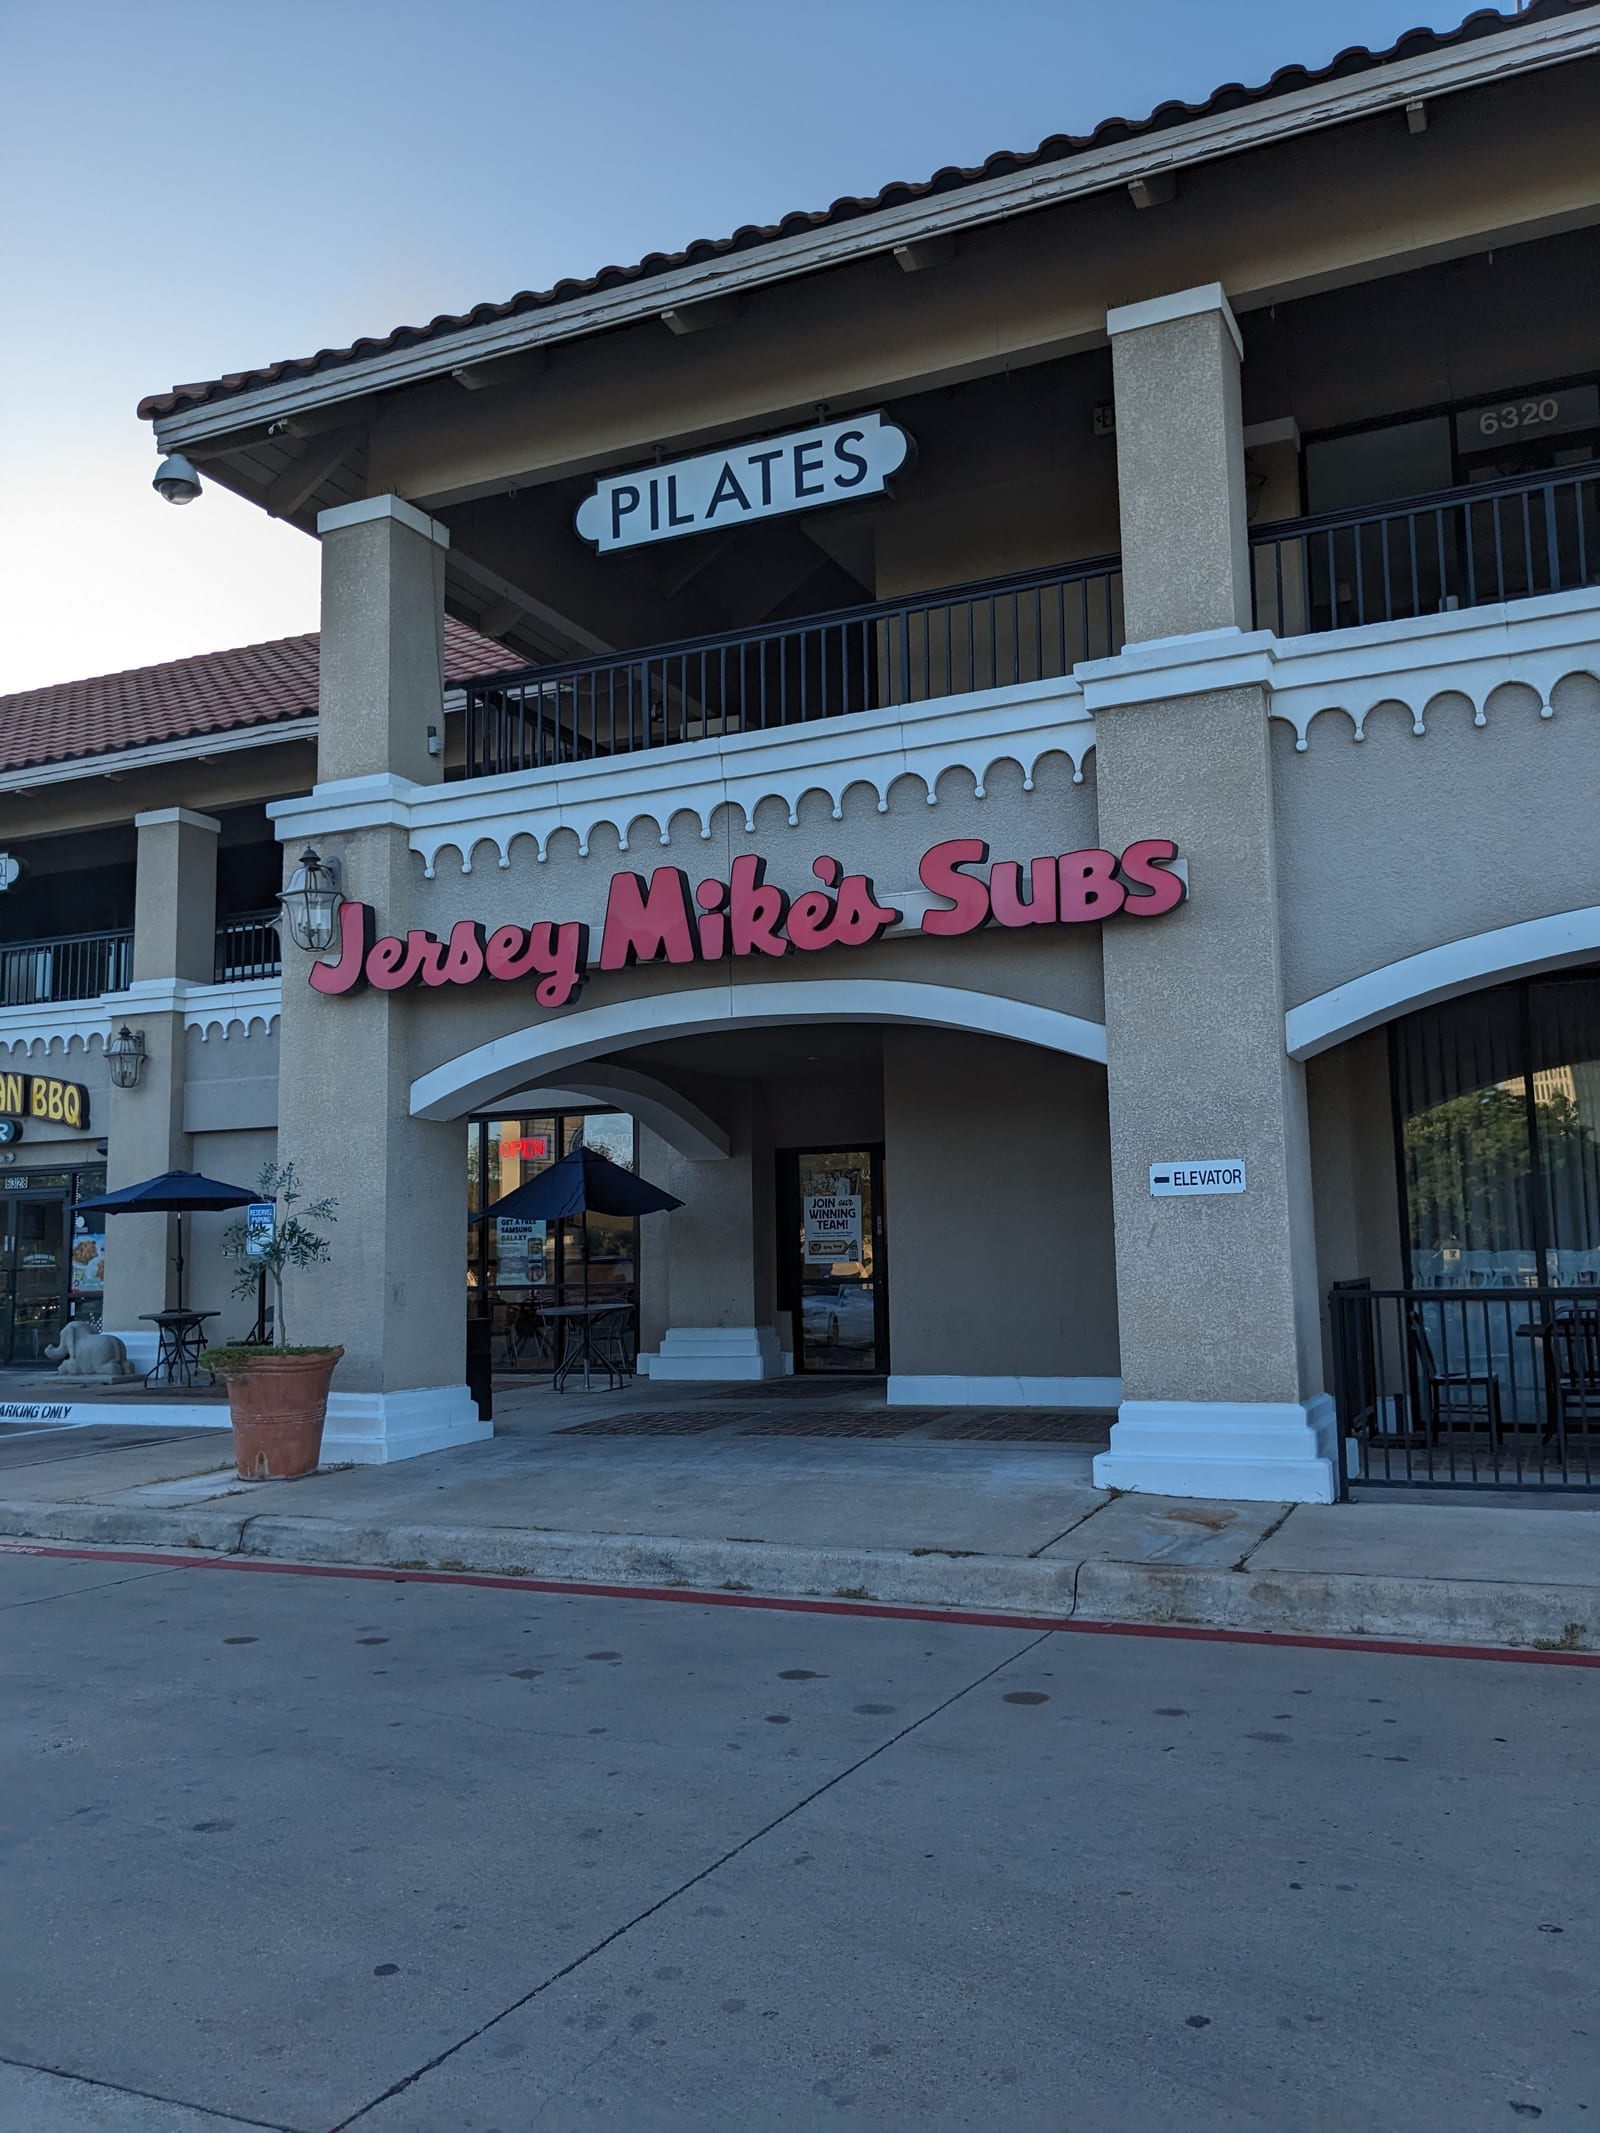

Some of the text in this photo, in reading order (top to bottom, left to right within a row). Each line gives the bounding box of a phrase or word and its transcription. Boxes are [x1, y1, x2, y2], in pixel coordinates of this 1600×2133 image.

[1480, 399, 1559, 434] 6320
[611, 430, 868, 539] PILATES
[308, 901, 587, 1008] Jersey
[601, 854, 902, 971] Mike's
[32, 1078, 80, 1128] BBQ
[499, 1138, 546, 1159] OPEN
[1173, 1168, 1242, 1187] ELEVATOR
[809, 1208, 856, 1219] WINNING
[812, 1198, 835, 1209] JOIN
[817, 1219, 849, 1230] TEAM!
[41, 1405, 72, 1419] ONLY
